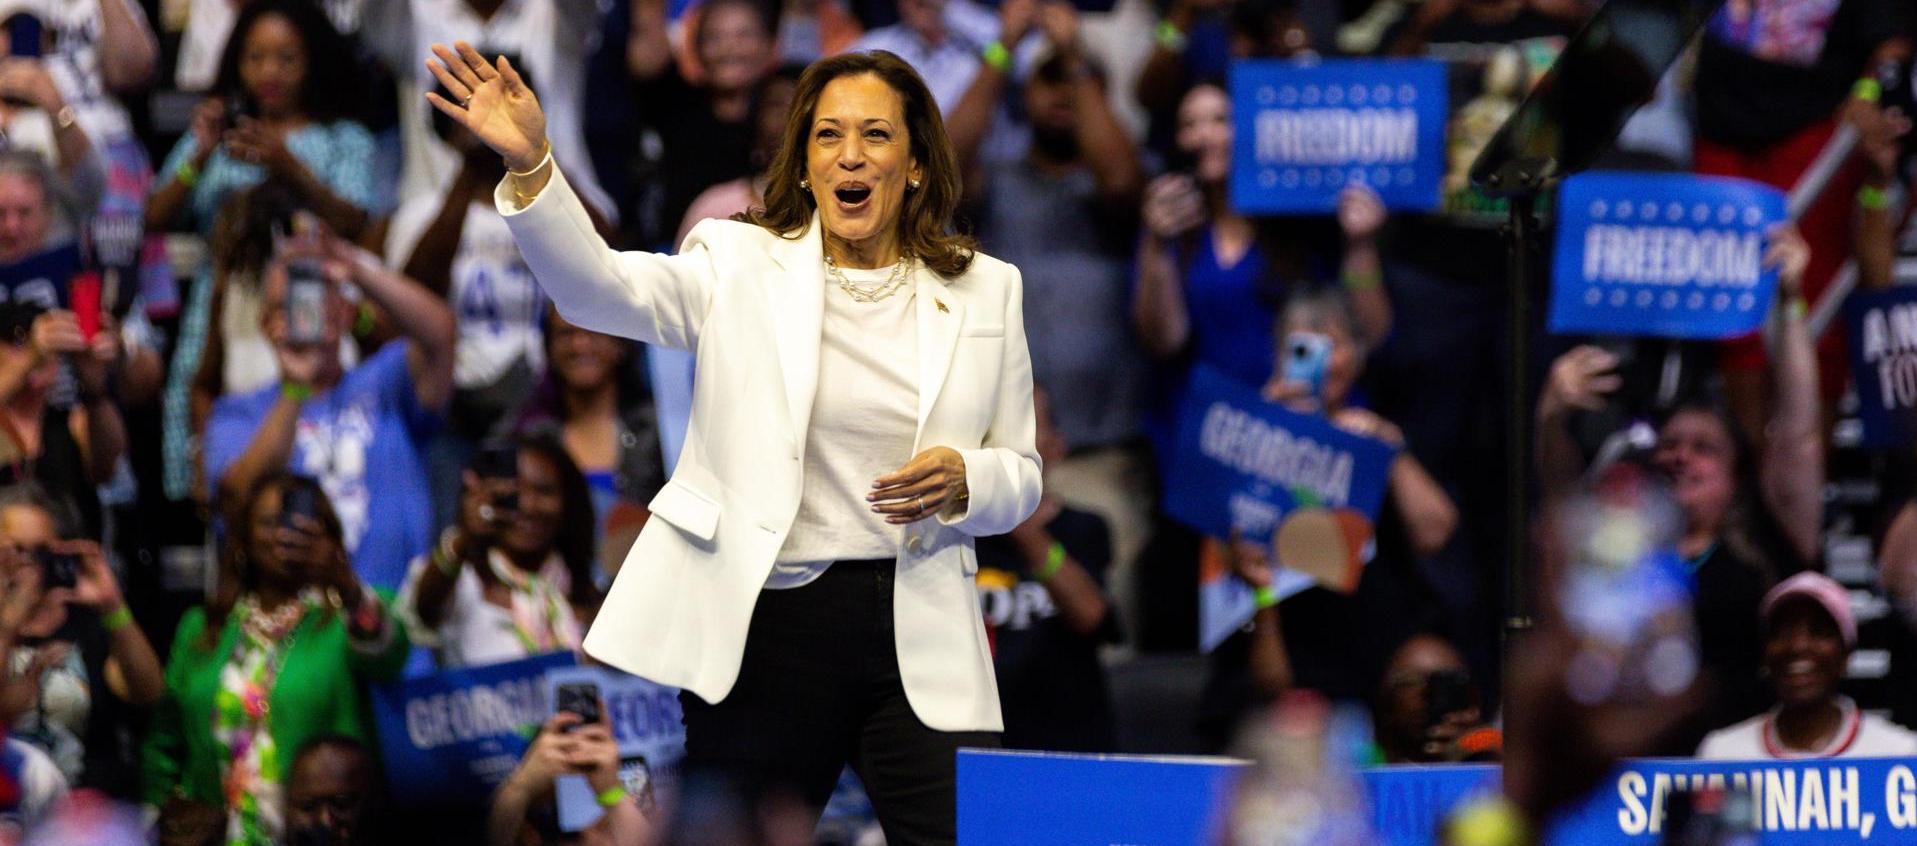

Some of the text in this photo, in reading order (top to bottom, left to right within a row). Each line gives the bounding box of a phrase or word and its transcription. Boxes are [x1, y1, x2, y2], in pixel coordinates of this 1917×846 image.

[1255, 107, 1418, 166] FREEDOM
[1583, 224, 1760, 289] FREEDOM
[1200, 401, 1354, 505] GEORGIA
[1617, 766, 1876, 839] SANNAH,
